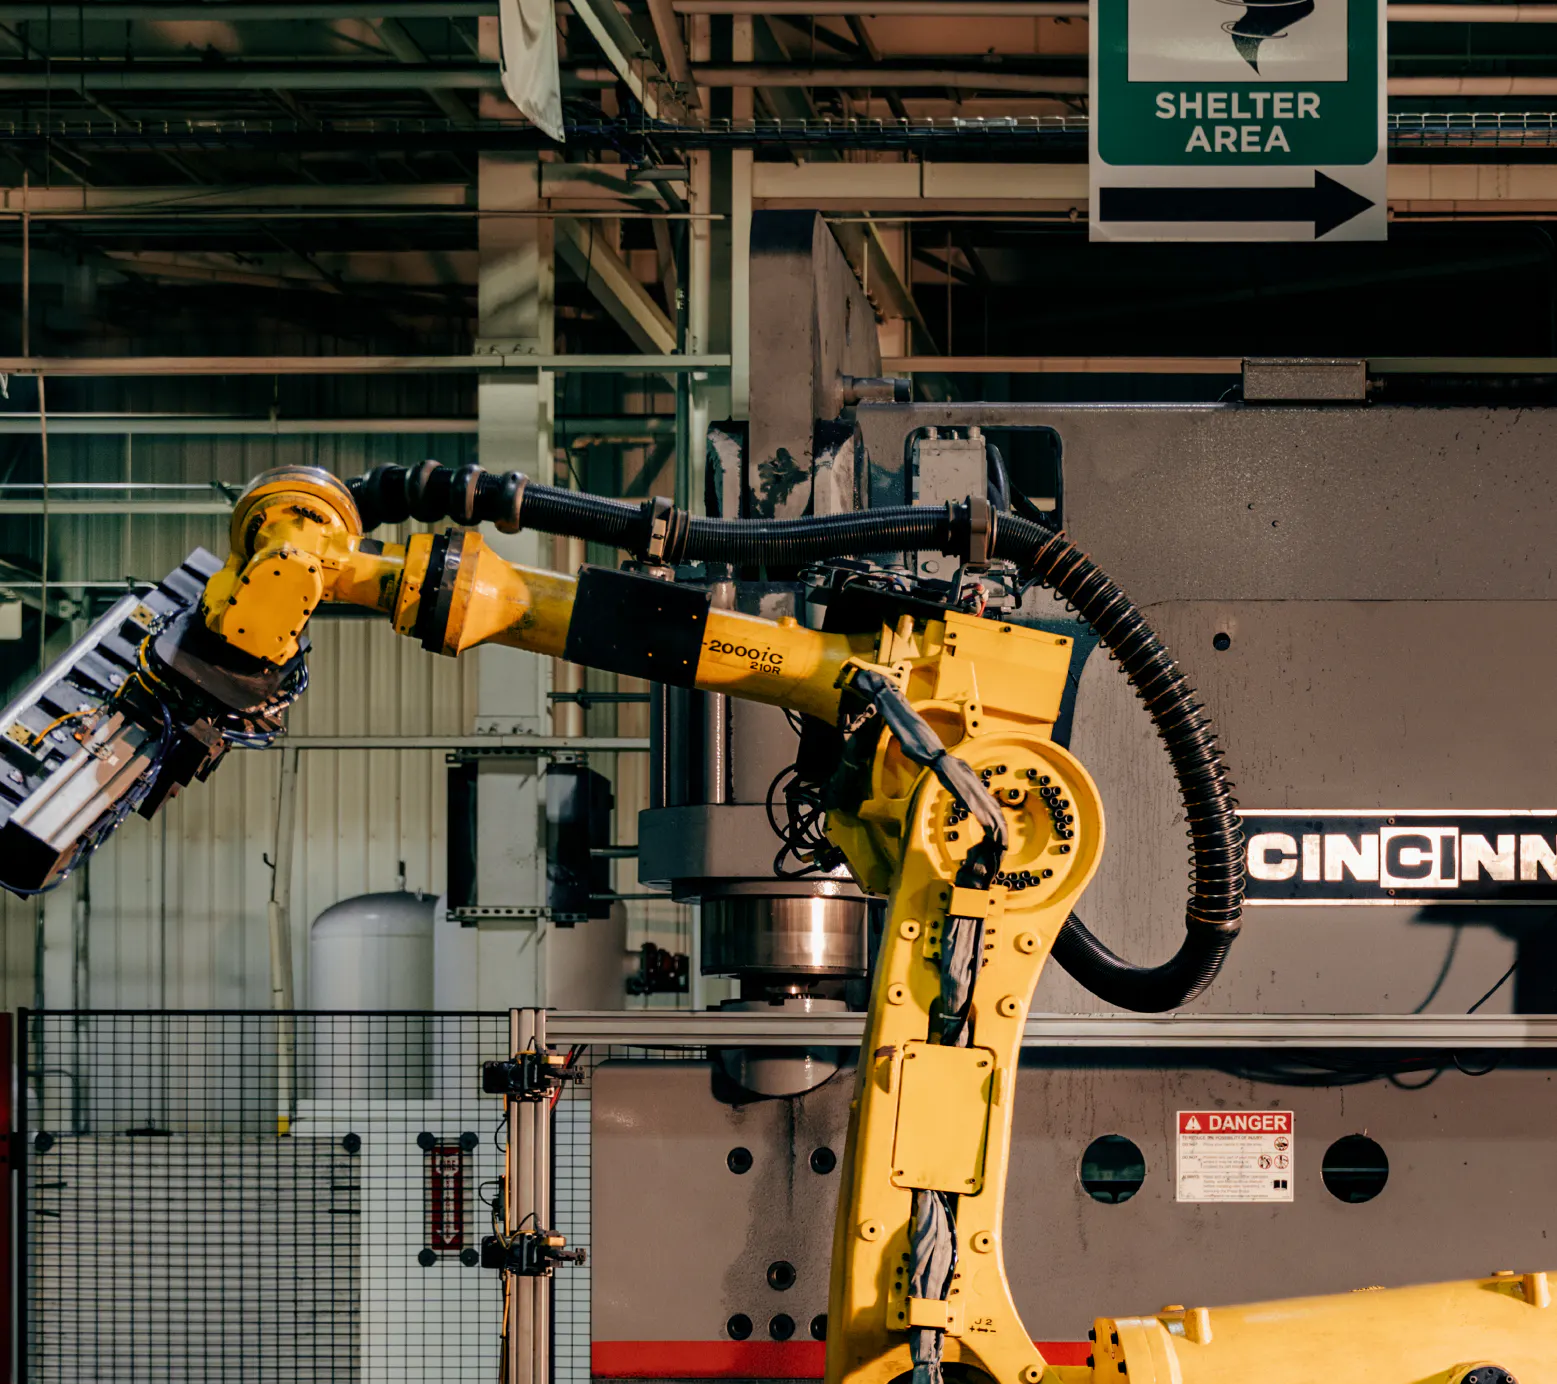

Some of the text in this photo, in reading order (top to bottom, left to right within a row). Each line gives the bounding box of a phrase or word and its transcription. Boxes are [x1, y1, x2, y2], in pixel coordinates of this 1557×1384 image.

[1155, 92, 1321, 119] SHELTER
[1185, 125, 1291, 153] AREA
[749, 661, 782, 675] 210R
[1209, 1115, 1287, 1131] DANGER
